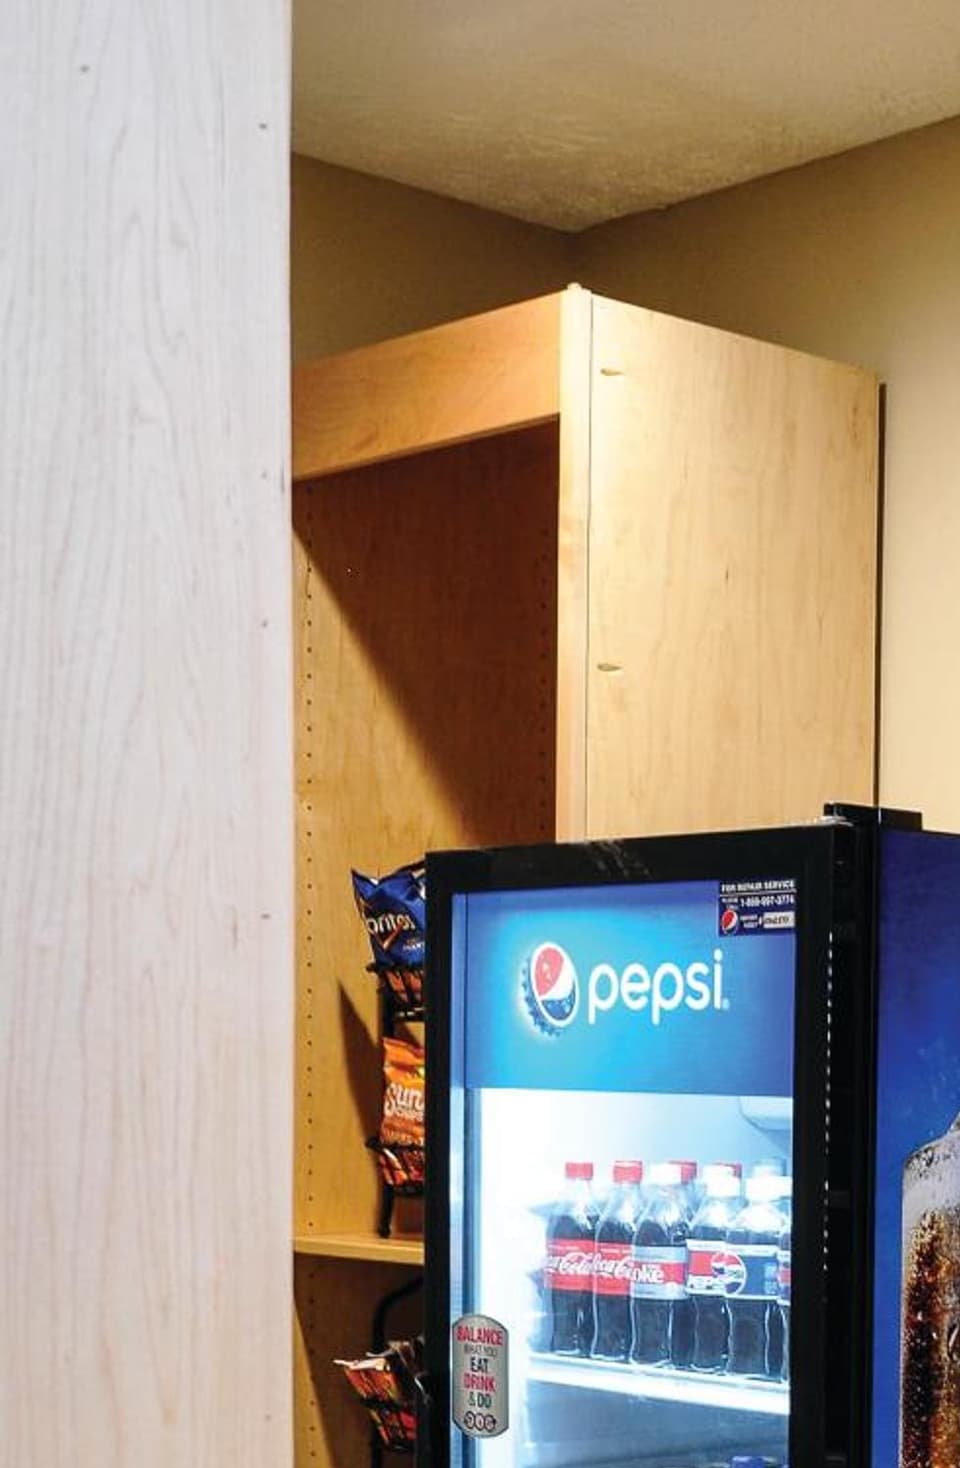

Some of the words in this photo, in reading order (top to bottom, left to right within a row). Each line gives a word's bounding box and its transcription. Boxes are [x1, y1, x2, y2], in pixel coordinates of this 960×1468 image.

[366, 913, 416, 935] oritos
[588, 949, 724, 1025] pepsi
[457, 1326, 503, 1345] BALANCE
[470, 1357, 488, 1373] EAT
[463, 1373, 496, 1392] DRINK
[477, 1393, 492, 1409] DO
